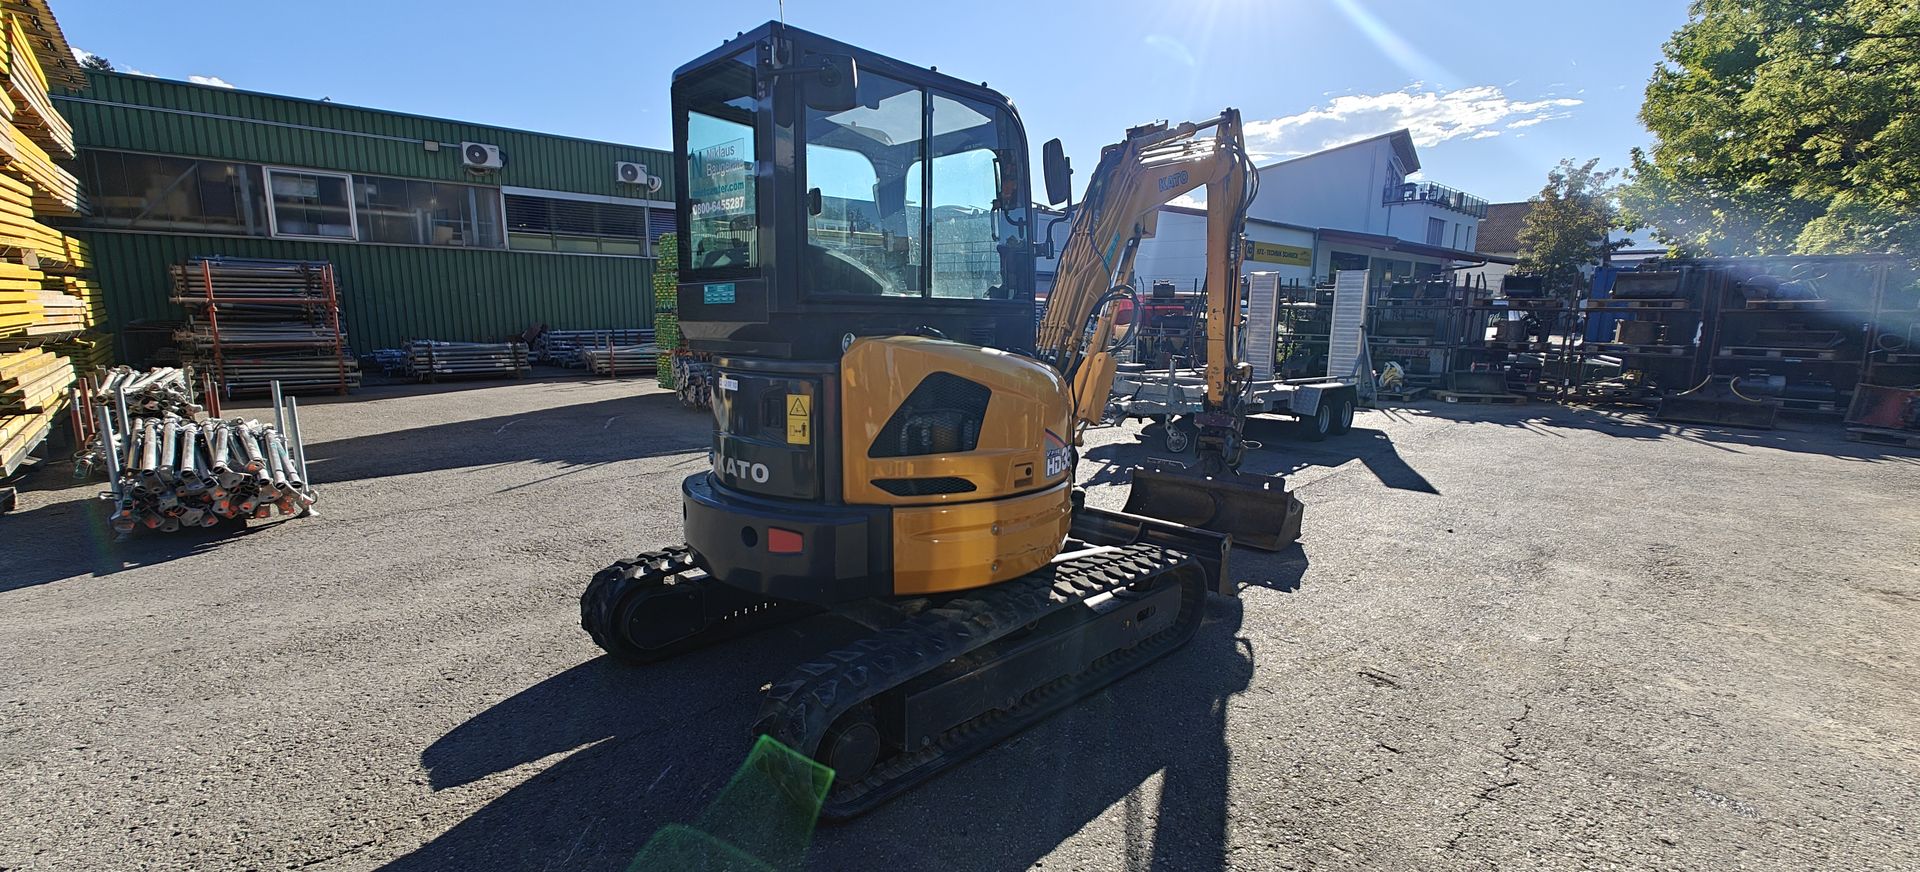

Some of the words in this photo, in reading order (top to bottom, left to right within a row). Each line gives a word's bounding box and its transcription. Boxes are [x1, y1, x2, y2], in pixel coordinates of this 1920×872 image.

[706, 145, 735, 161] Niklaus
[1158, 170, 1189, 192] KATO
[692, 196, 745, 215] 0800-6455287
